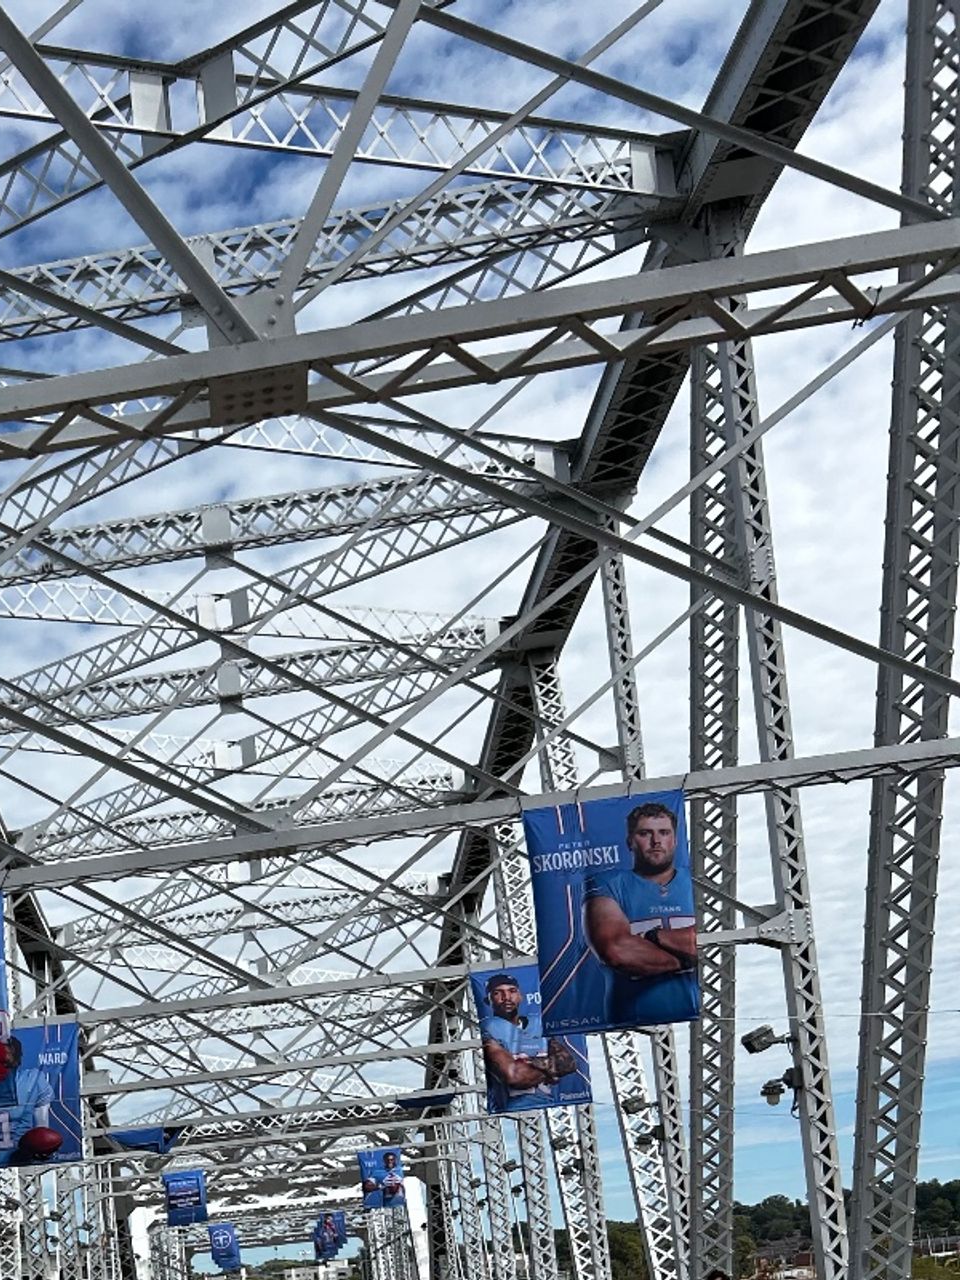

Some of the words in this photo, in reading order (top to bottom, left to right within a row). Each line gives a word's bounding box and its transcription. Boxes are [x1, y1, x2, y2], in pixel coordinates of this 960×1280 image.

[532, 845, 621, 873] SKORONSKI
[545, 1016, 600, 1029] NISSAN
[38, 1051, 68, 1065] WARD
